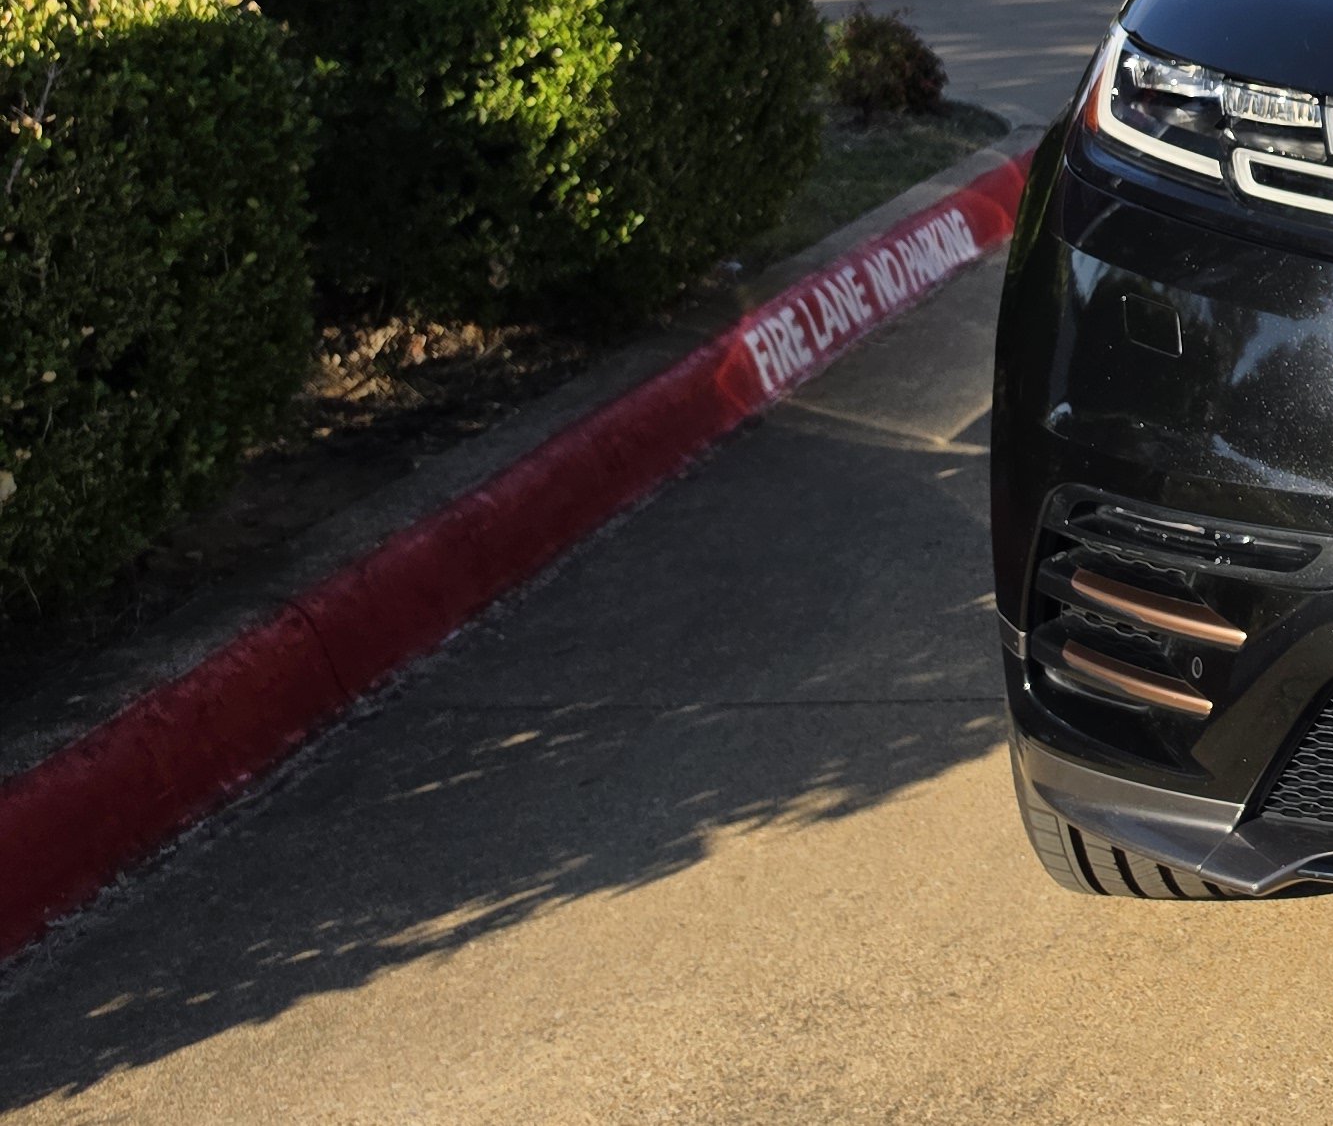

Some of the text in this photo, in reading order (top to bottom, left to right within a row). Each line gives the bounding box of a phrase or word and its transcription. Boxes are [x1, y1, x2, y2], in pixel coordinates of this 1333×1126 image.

[743, 209, 979, 392] FIRE LANE NO PARKING
